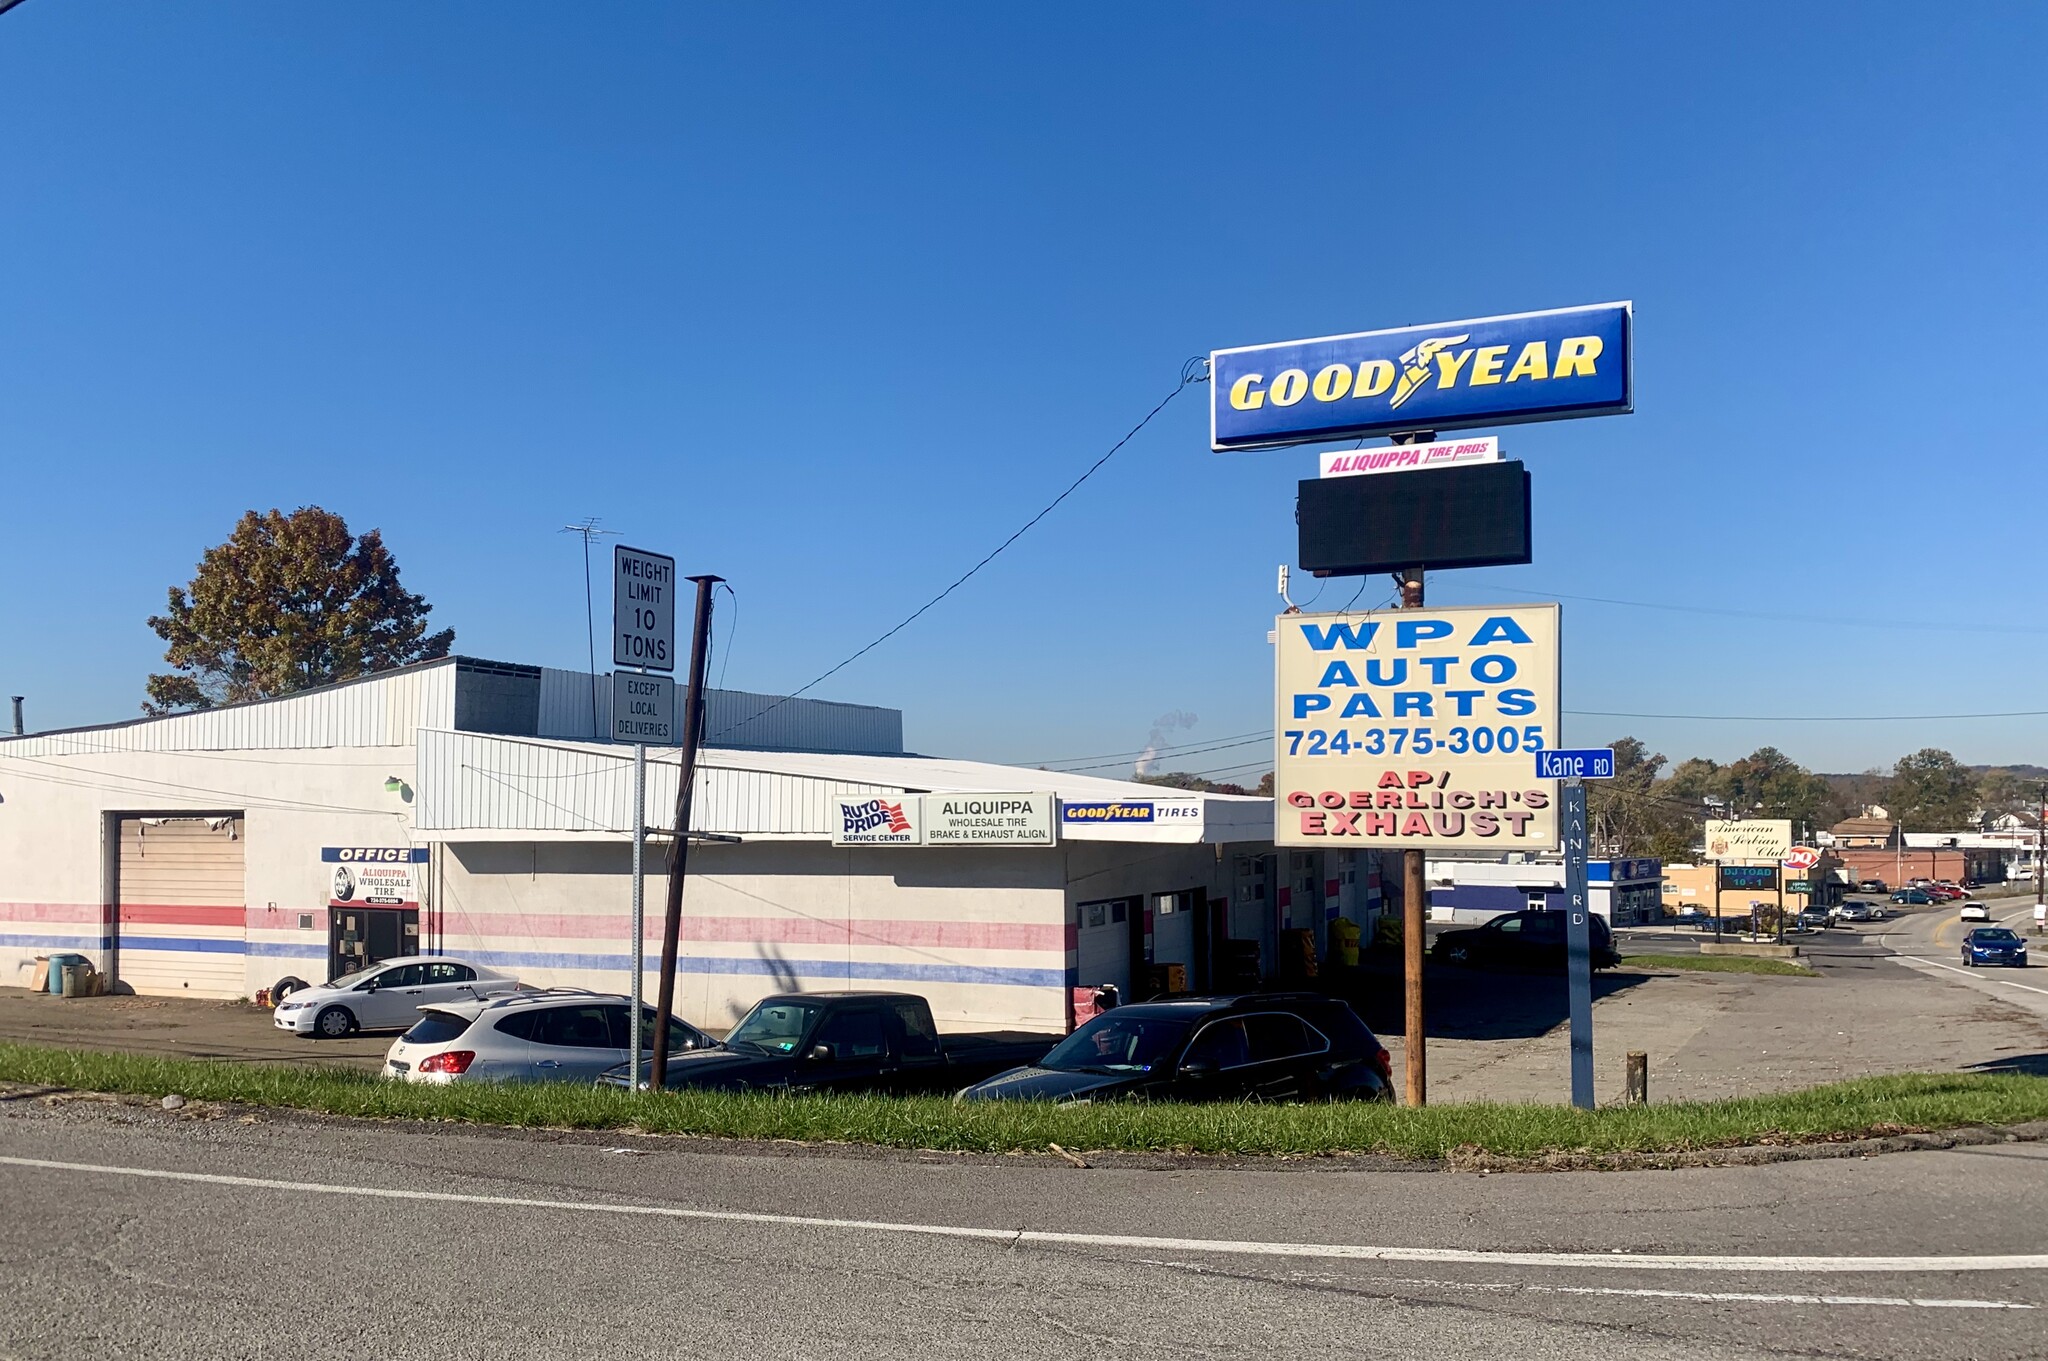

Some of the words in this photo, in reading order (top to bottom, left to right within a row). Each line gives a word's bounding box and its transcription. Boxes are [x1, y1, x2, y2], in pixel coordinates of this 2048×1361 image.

[1229, 334, 1604, 410] GOODYEAR
[1328, 449, 1421, 473] ALIQUIPPA
[1424, 446, 1454, 464] TIRE
[1452, 442, 1489, 461] PROS
[621, 557, 670, 583] WEIGHT
[628, 581, 662, 604] LIMIT
[634, 607, 656, 631] 10
[1300, 616, 1535, 652] WPA
[623, 634, 666, 661] TONS
[1317, 654, 1518, 688] AUTO
[627, 680, 661, 697] EXCEPT
[630, 701, 658, 716] LOCAL
[1293, 689, 1537, 720] PARTS
[618, 720, 668, 737] DELIVERIES
[1285, 726, 1546, 757] 724-375-3005
[1542, 752, 1584, 776] Kane
[1594, 758, 1609, 775] RD
[1377, 770, 1451, 789] AP/
[840, 799, 880, 819] AUTO
[942, 801, 1033, 815] ALIQUIPPA
[1287, 790, 1550, 811] GOERLICH'S
[1067, 805, 1150, 820] GOODYEAR
[1157, 807, 1199, 817] TIRES
[843, 809, 893, 834] PRIDE
[948, 818, 1004, 827] WHOLESALE
[1007, 817, 1027, 827] TIRE
[1300, 811, 1535, 838] EXHAUST
[1709, 823, 1773, 833] American
[843, 834, 877, 842] SERVICE
[878, 834, 911, 842] CENTER
[930, 830, 960, 839] BRAKE
[962, 830, 970, 839] &
[971, 830, 1014, 839] EXHAUST
[1017, 829, 1048, 838] ALIGN.
[1730, 834, 1779, 845] Serbian
[339, 848, 410, 861] OFFICE
[1756, 846, 1787, 857] Club
[1788, 852, 1812, 863] DQ
[362, 867, 407, 878] ALIQUIPPA
[1724, 868, 1738, 876] DJ
[1742, 868, 1772, 876] TOAD
[359, 877, 411, 887] WHOLESALE
[374, 887, 395, 896] TIRE
